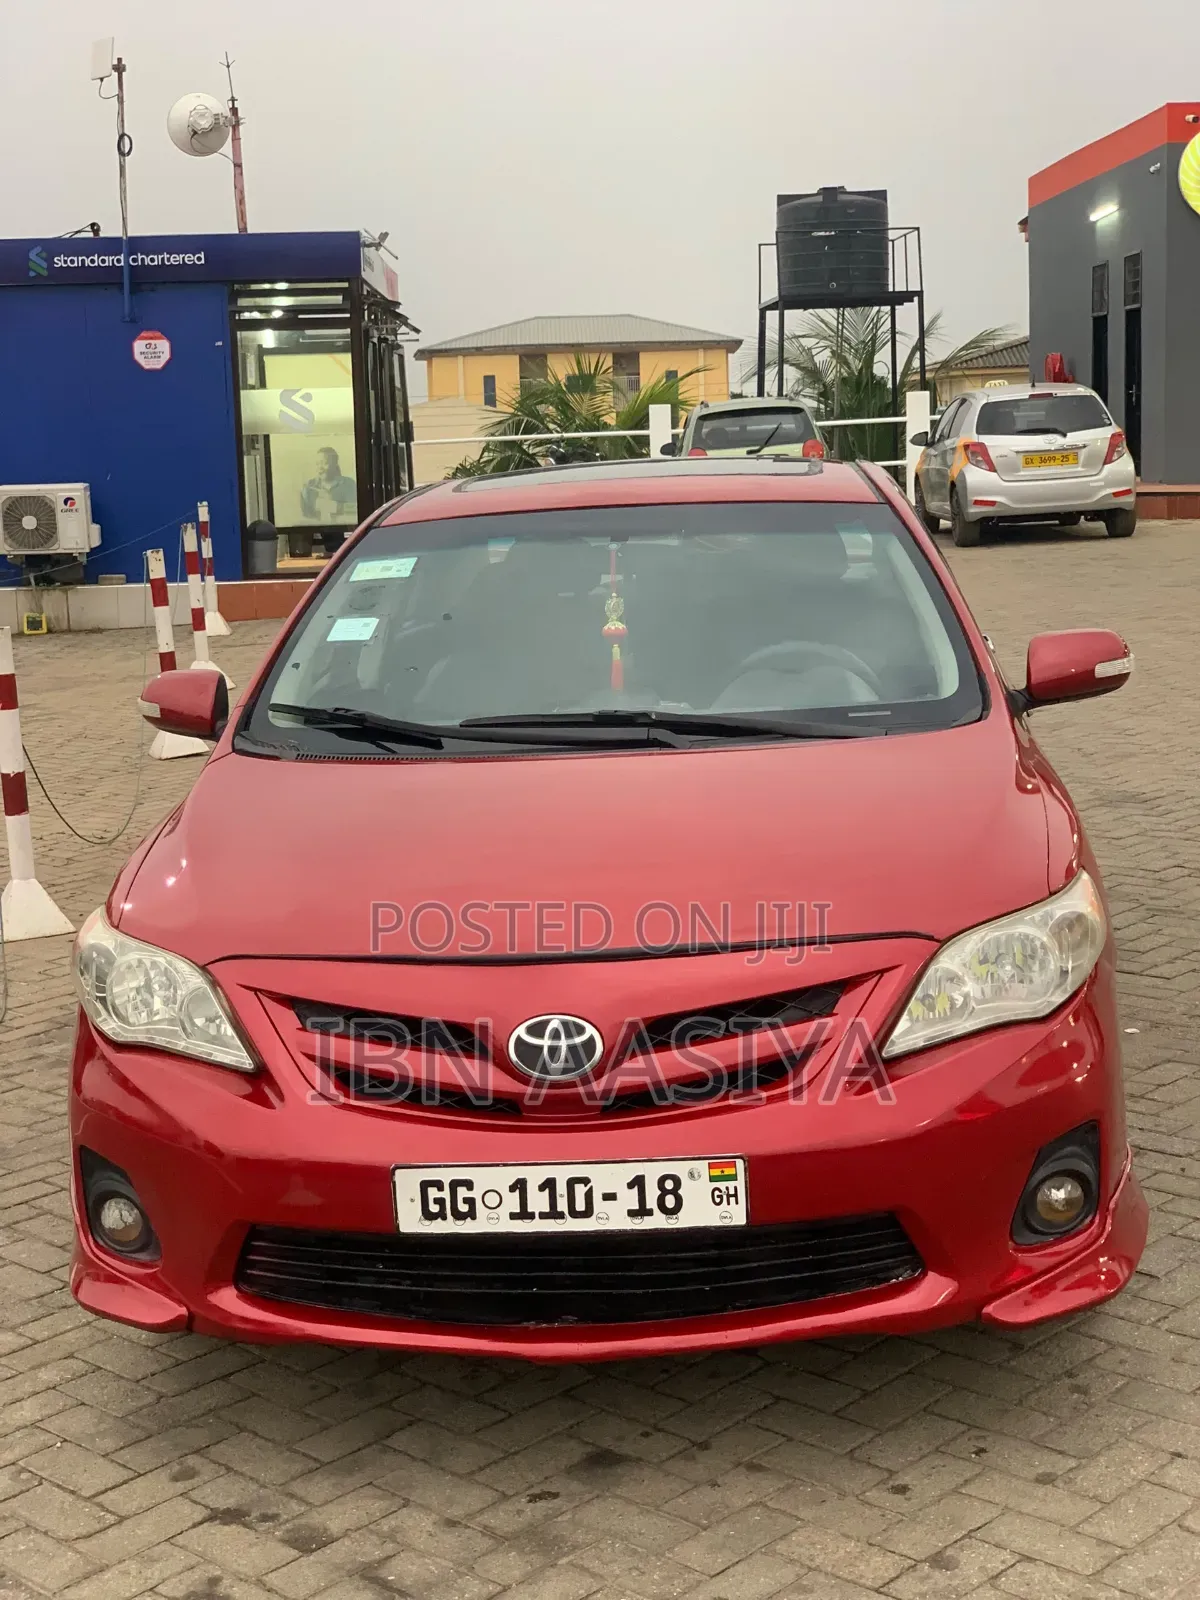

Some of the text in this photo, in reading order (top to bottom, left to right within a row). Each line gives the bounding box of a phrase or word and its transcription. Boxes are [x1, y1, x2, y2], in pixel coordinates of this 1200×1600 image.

[53, 251, 205, 268] standard chartered
[1024, 457, 1035, 466] GX
[1038, 454, 1070, 465] 3699-25
[419, 1173, 684, 1222] GG 110-18
[710, 1185, 740, 1207] GH
